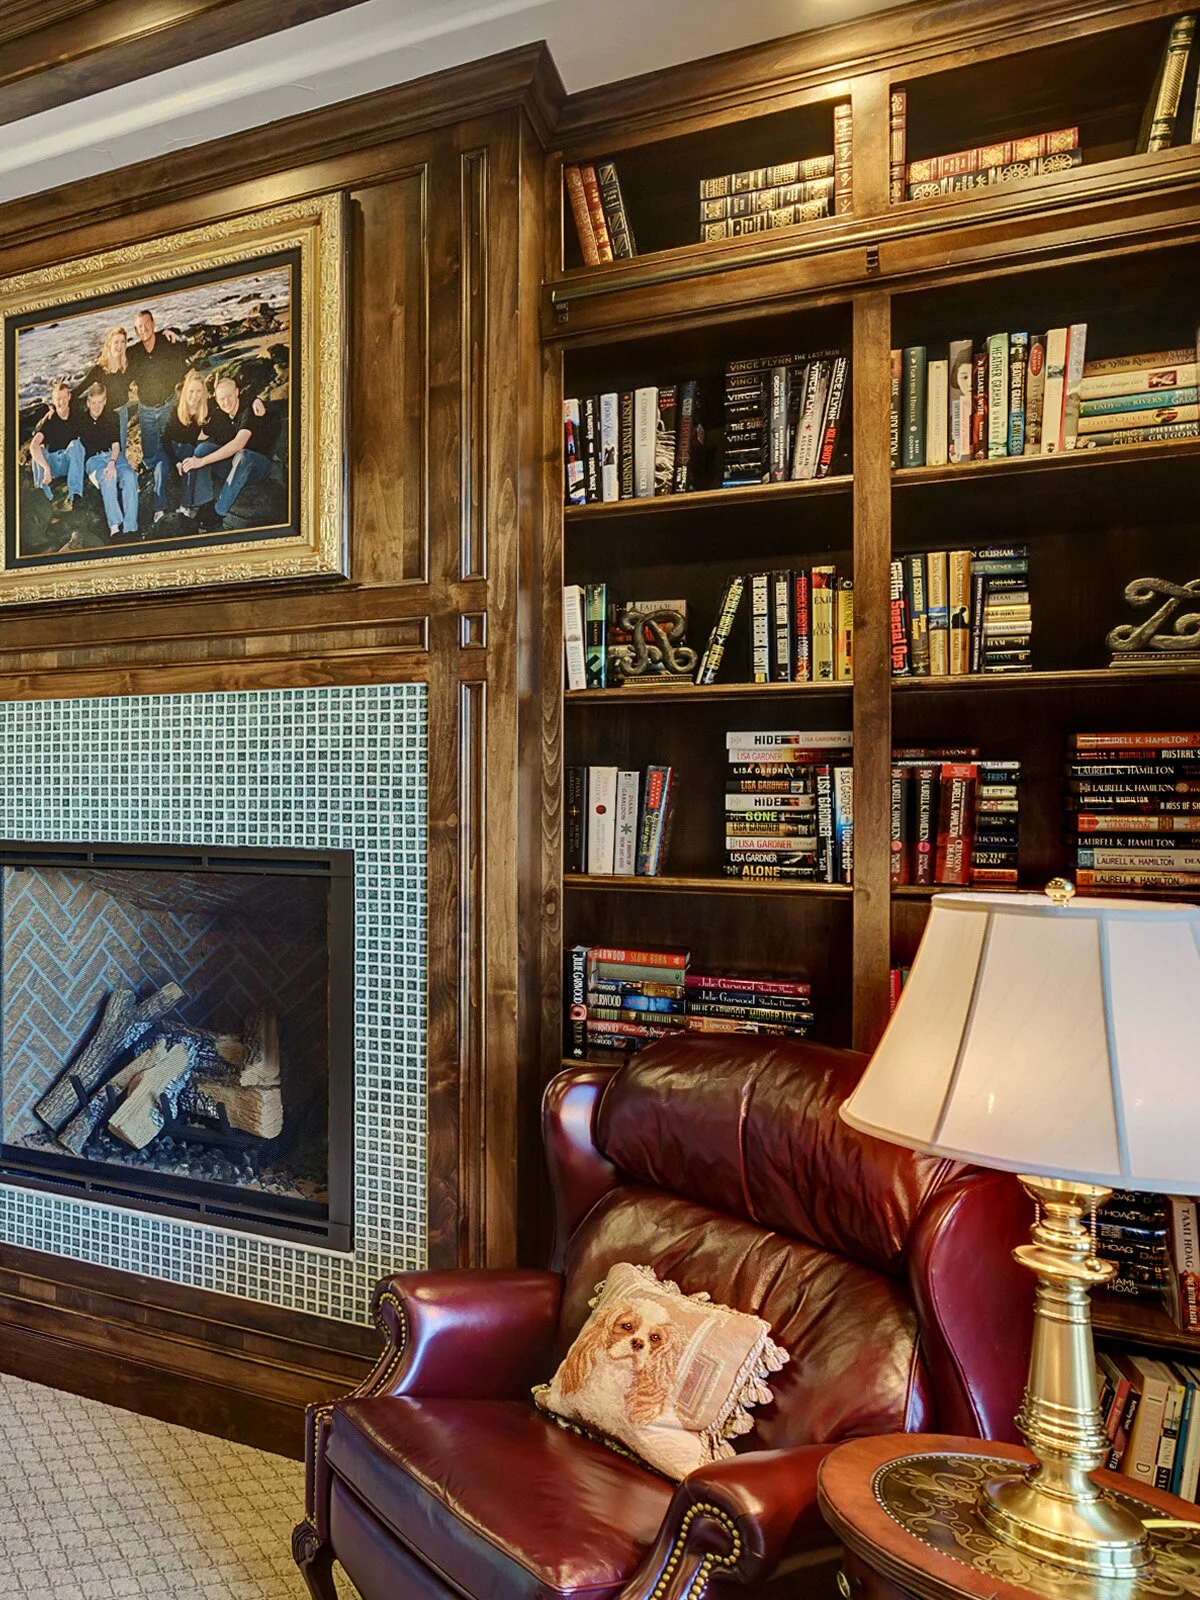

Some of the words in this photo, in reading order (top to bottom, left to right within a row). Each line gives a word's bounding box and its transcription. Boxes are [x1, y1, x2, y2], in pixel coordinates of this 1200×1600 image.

[729, 362, 759, 372] VINCE
[761, 358, 792, 367] FLYNN
[990, 346, 1002, 378] HEATHER
[729, 377, 759, 387] VINCE
[808, 362, 820, 394] VINCE
[834, 361, 846, 390] VINCE
[1011, 362, 1022, 388] HEATHER
[772, 375, 781, 397] ORDER
[990, 379, 1002, 408] GRAHAM
[727, 392, 759, 401] VINCE
[772, 397, 781, 406] TO
[1011, 389, 1022, 412] GRAHAM
[622, 401, 632, 426] JOSEPH
[772, 406, 781, 420] KILL
[804, 394, 814, 421] FLYNN
[828, 391, 841, 420] FLYNN
[730, 422, 745, 431] THE
[1011, 413, 1023, 454] FLAWLESS
[1113, 428, 1145, 438] KING'S
[1150, 422, 1198, 433] PHILIPPA
[622, 428, 632, 455] FINDER
[726, 433, 757, 443] VINCE
[825, 428, 837, 444] KILL
[1112, 436, 1144, 445] CURSE
[1148, 430, 1199, 441] GREGORY
[798, 436, 807, 466] ASSASSIN
[804, 434, 813, 466] AMERICAN
[821, 444, 832, 464] SHOT
[622, 456, 633, 494] VANISHED
[978, 549, 1014, 559] GRISHAM
[932, 556, 940, 574] JOHN
[890, 562, 904, 601] Griffin
[932, 574, 940, 605] GRISHAM
[890, 600, 907, 644] Special
[891, 646, 908, 669] Ops
[754, 735, 781, 745] HIDE
[1145, 736, 1189, 744] HAMILTON
[736, 752, 751, 761] LISA
[751, 752, 782, 761] GARDNER
[840, 770, 851, 785] LISA
[1077, 767, 1114, 775] LAURELL
[1116, 766, 1126, 775] K.
[1127, 766, 1175, 775] HAMILTON
[740, 781, 756, 790] LISA
[757, 781, 790, 790] GARDNER
[817, 776, 831, 795] LISA
[891, 779, 902, 805] LAURELL
[920, 780, 930, 805] LAURELL
[951, 778, 962, 803] LAURELL
[1092, 783, 1125, 792] LAURELL
[1124, 783, 1134, 792] K.
[1134, 783, 1175, 792] HAMILTON
[754, 797, 781, 807] HIDE
[840, 784, 852, 815] GARDNER
[1160, 802, 1165, 810] A
[1166, 802, 1181, 810] KISS
[1182, 802, 1191, 810] OF
[745, 811, 778, 822] GONE
[818, 797, 832, 837] GARDNER
[891, 810, 902, 840] HAMILTON
[948, 809, 959, 838] HAMILTON
[732, 823, 747, 832] LISA
[748, 823, 780, 832] GARDNER
[919, 811, 930, 842] HAMILTON
[1106, 822, 1151, 830] HAMILTON
[738, 839, 755, 848] LISA
[756, 840, 792, 849] GARDNER
[841, 825, 853, 851] TOUCH
[1077, 837, 1115, 846] LAURELL
[1116, 838, 1126, 847] K.
[1127, 838, 1175, 847] HAMILTON
[730, 853, 746, 862] LISA
[745, 853, 778, 863] GARDNER
[841, 857, 853, 870] GO
[945, 844, 955, 868] DEATH
[954, 839, 963, 873] CRIMSON
[1096, 857, 1127, 866] LAURELL
[1129, 857, 1137, 865] K.
[1138, 857, 1175, 866] HAMILTON
[742, 865, 780, 877] ALONE
[1094, 875, 1129, 884] LAURELL
[1140, 876, 1180, 886] HAMILTON
[572, 954, 583, 971] JULIE
[630, 952, 648, 963] SLOW
[650, 953, 668, 965] BURN
[572, 971, 584, 1004] GARWOOD
[698, 977, 717, 987] Julie
[717, 978, 755, 991] Garwood
[698, 991, 719, 1001] Julie
[719, 992, 756, 1005] Garwood
[749, 1009, 779, 1021] MURDER
[781, 1011, 797, 1022] LIST
[1104, 1210, 1136, 1221] HOAG
[1181, 1208, 1191, 1236] TAMI
[1102, 1244, 1134, 1254] HOAG
[1184, 1238, 1194, 1268] HOAG
[1106, 1283, 1139, 1295] HOAG
[1187, 1286, 1196, 1304] BITTER
[1189, 1304, 1197, 1324] SEASON
[1125, 1399, 1138, 1419] Anthony
[1123, 1418, 1132, 1430] Noel
[1109, 1450, 1124, 1470] Terra
[1161, 1439, 1174, 1466] HOME
